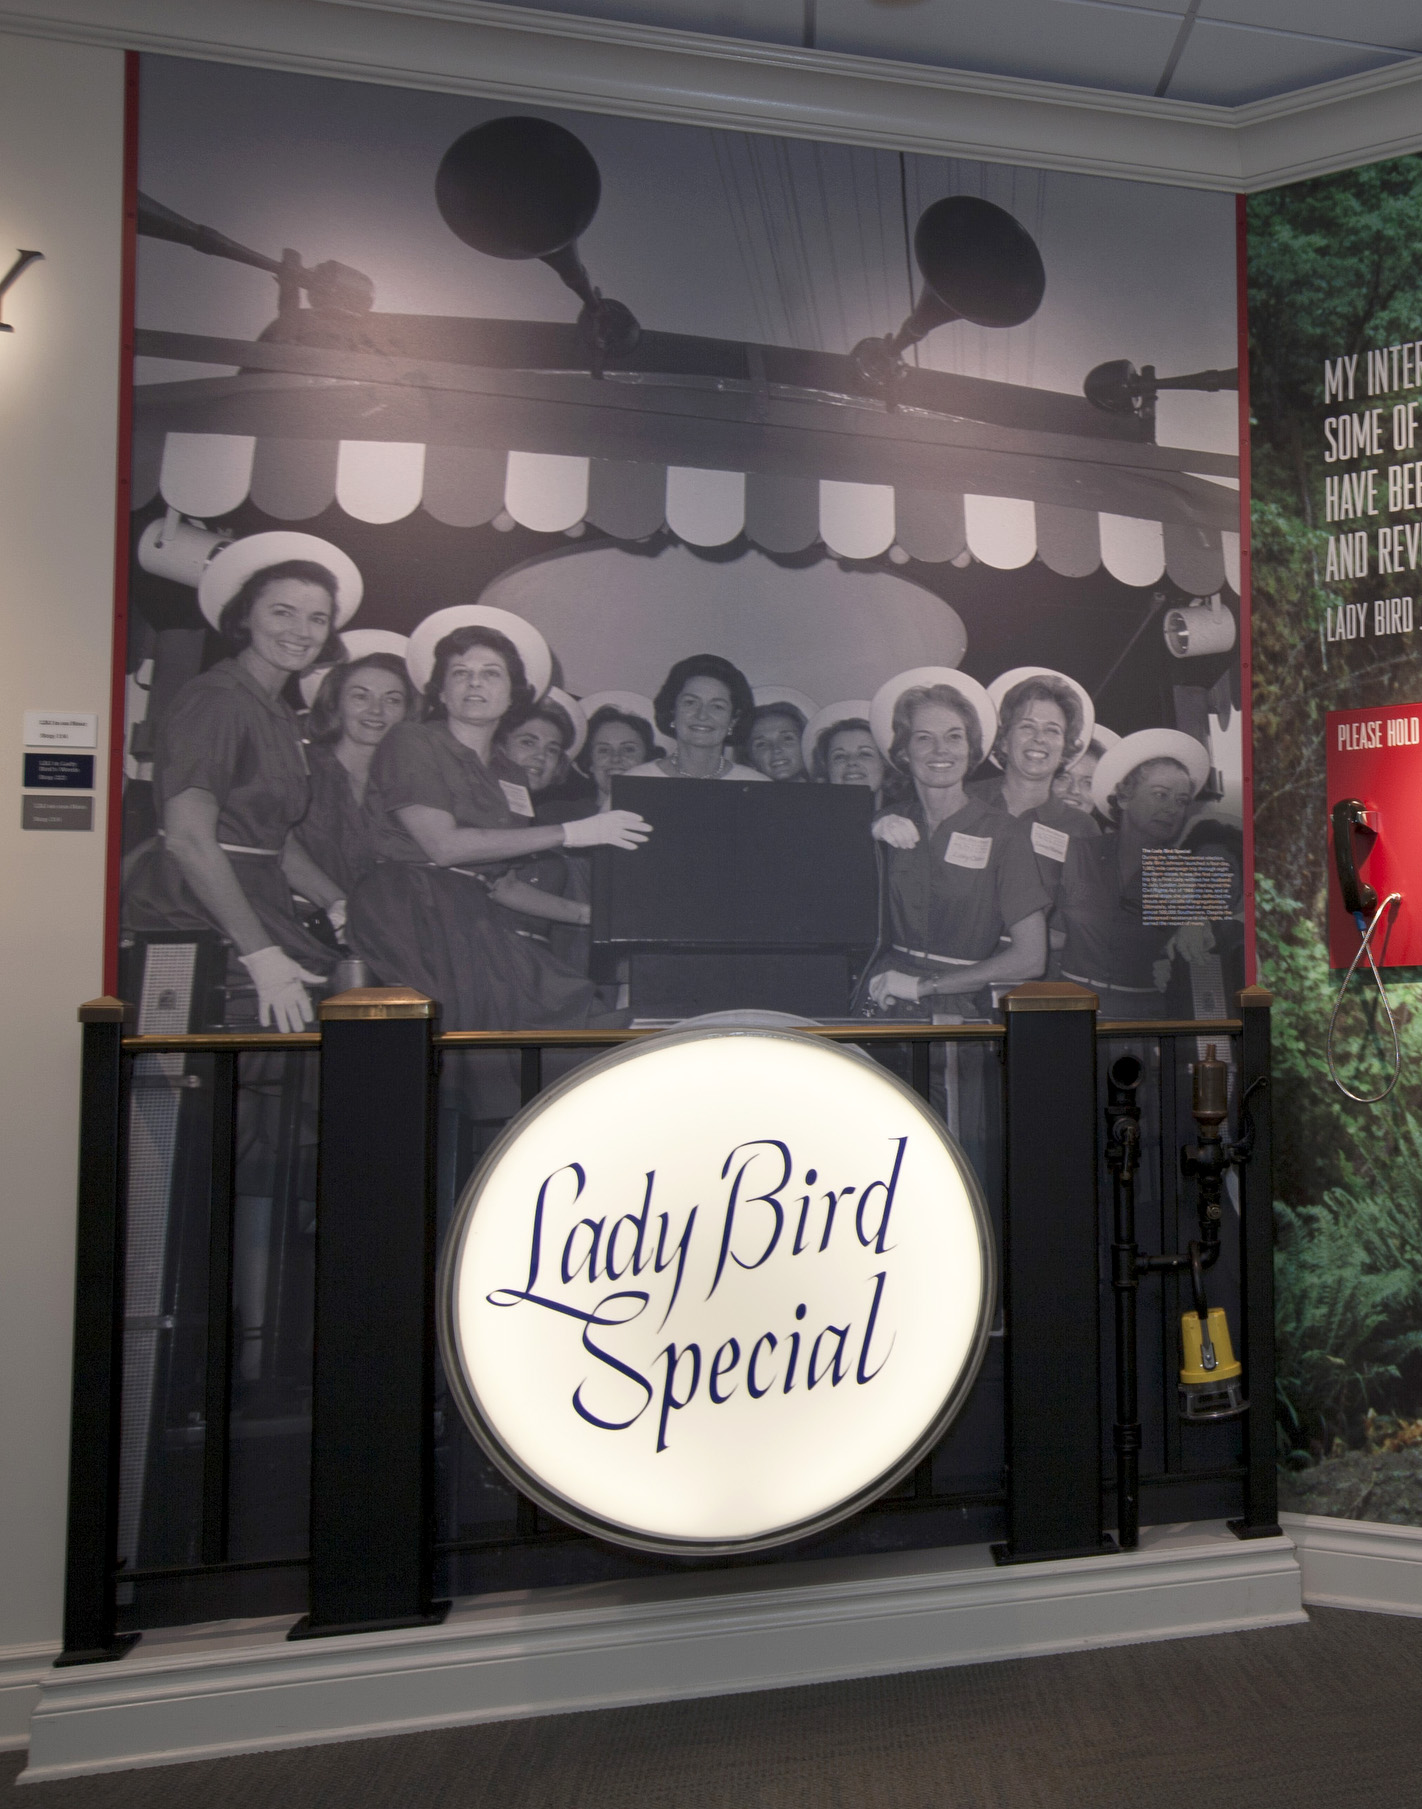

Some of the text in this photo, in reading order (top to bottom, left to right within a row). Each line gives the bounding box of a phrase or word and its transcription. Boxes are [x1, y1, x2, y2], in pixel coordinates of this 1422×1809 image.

[1325, 354, 1358, 404] MY
[1325, 409, 1383, 463] SOME
[1393, 401, 1419, 451] OF
[1325, 469, 1378, 522] HAVE
[1325, 531, 1368, 583] AND
[1327, 602, 1368, 642] LADY
[1374, 596, 1413, 637] BIRD
[1337, 721, 1382, 751] PLEASE
[1387, 717, 1420, 747] HOLD
[486, 1136, 909, 1334] Lady Bird
[572, 1271, 897, 1453] Special
